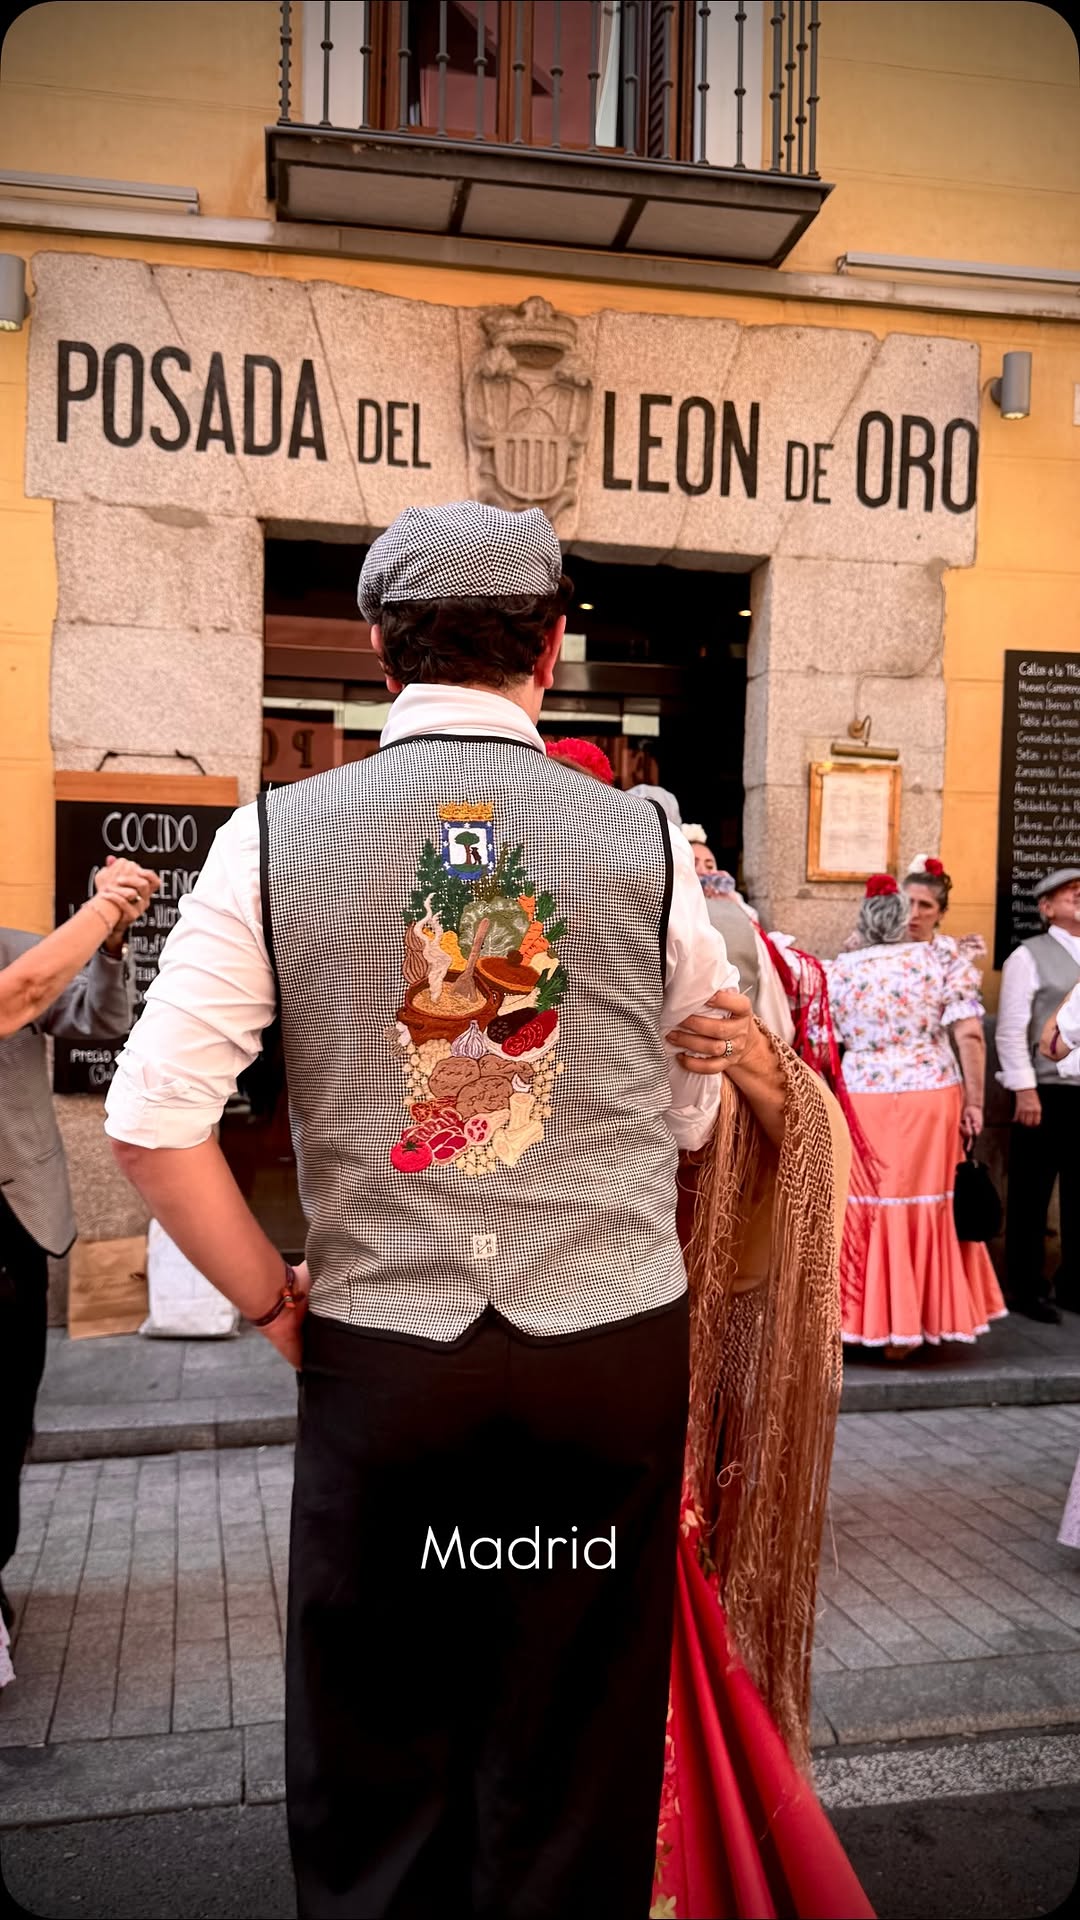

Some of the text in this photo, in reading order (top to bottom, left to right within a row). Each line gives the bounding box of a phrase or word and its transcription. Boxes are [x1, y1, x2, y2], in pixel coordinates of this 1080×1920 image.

[56, 339, 978, 514] POSADA DEL LEON DE ORO
[101, 811, 198, 854] COCIDO
